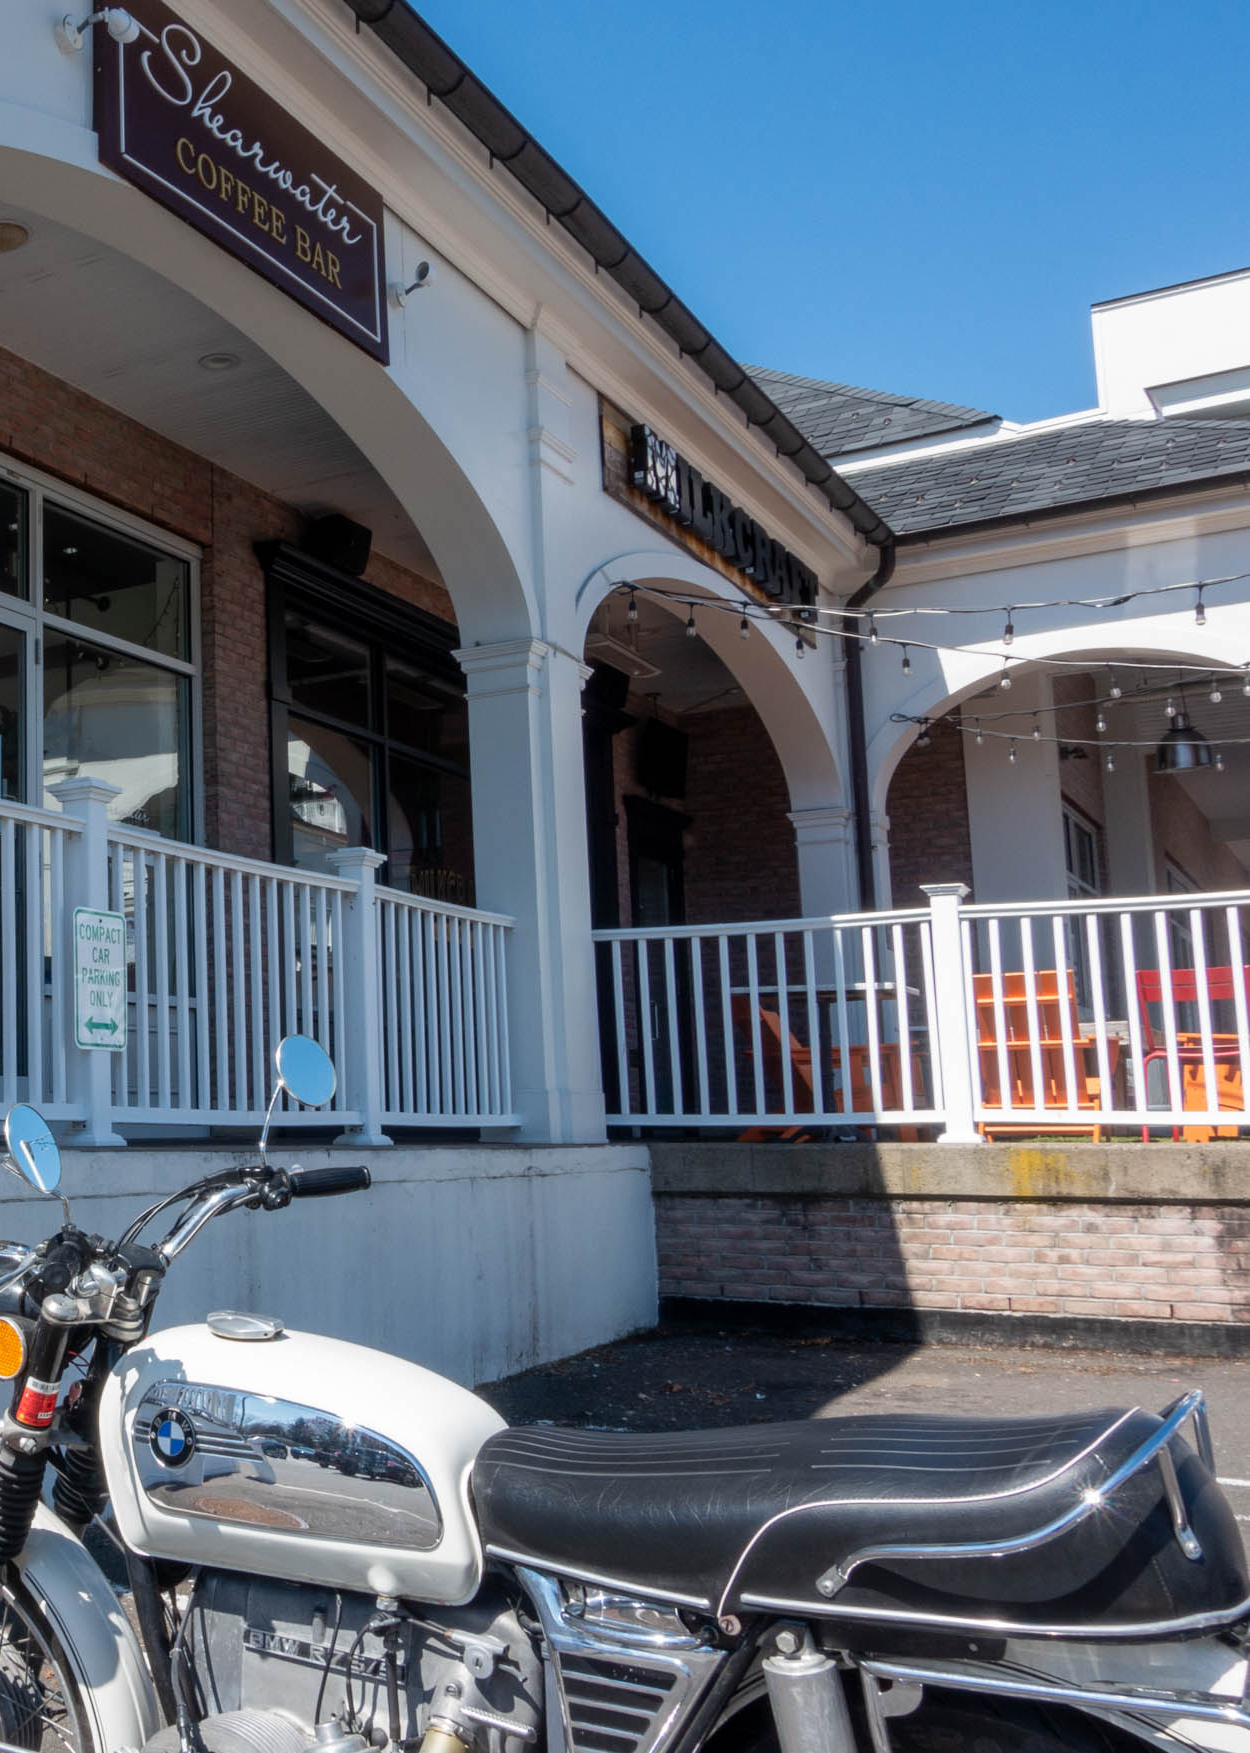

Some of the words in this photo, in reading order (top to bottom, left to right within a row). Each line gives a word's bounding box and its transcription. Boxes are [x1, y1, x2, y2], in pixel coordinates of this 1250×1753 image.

[141, 24, 362, 245] Shearwater
[175, 137, 288, 245] COFFEE
[294, 224, 343, 290] BAR
[632, 424, 819, 622] MILKCRAFT
[79, 923, 121, 945] COMPACT
[92, 947, 110, 965] CAR
[81, 967, 120, 987] PARKING
[90, 990, 113, 1008] ONLY
[250, 1631, 299, 1657] BMW
